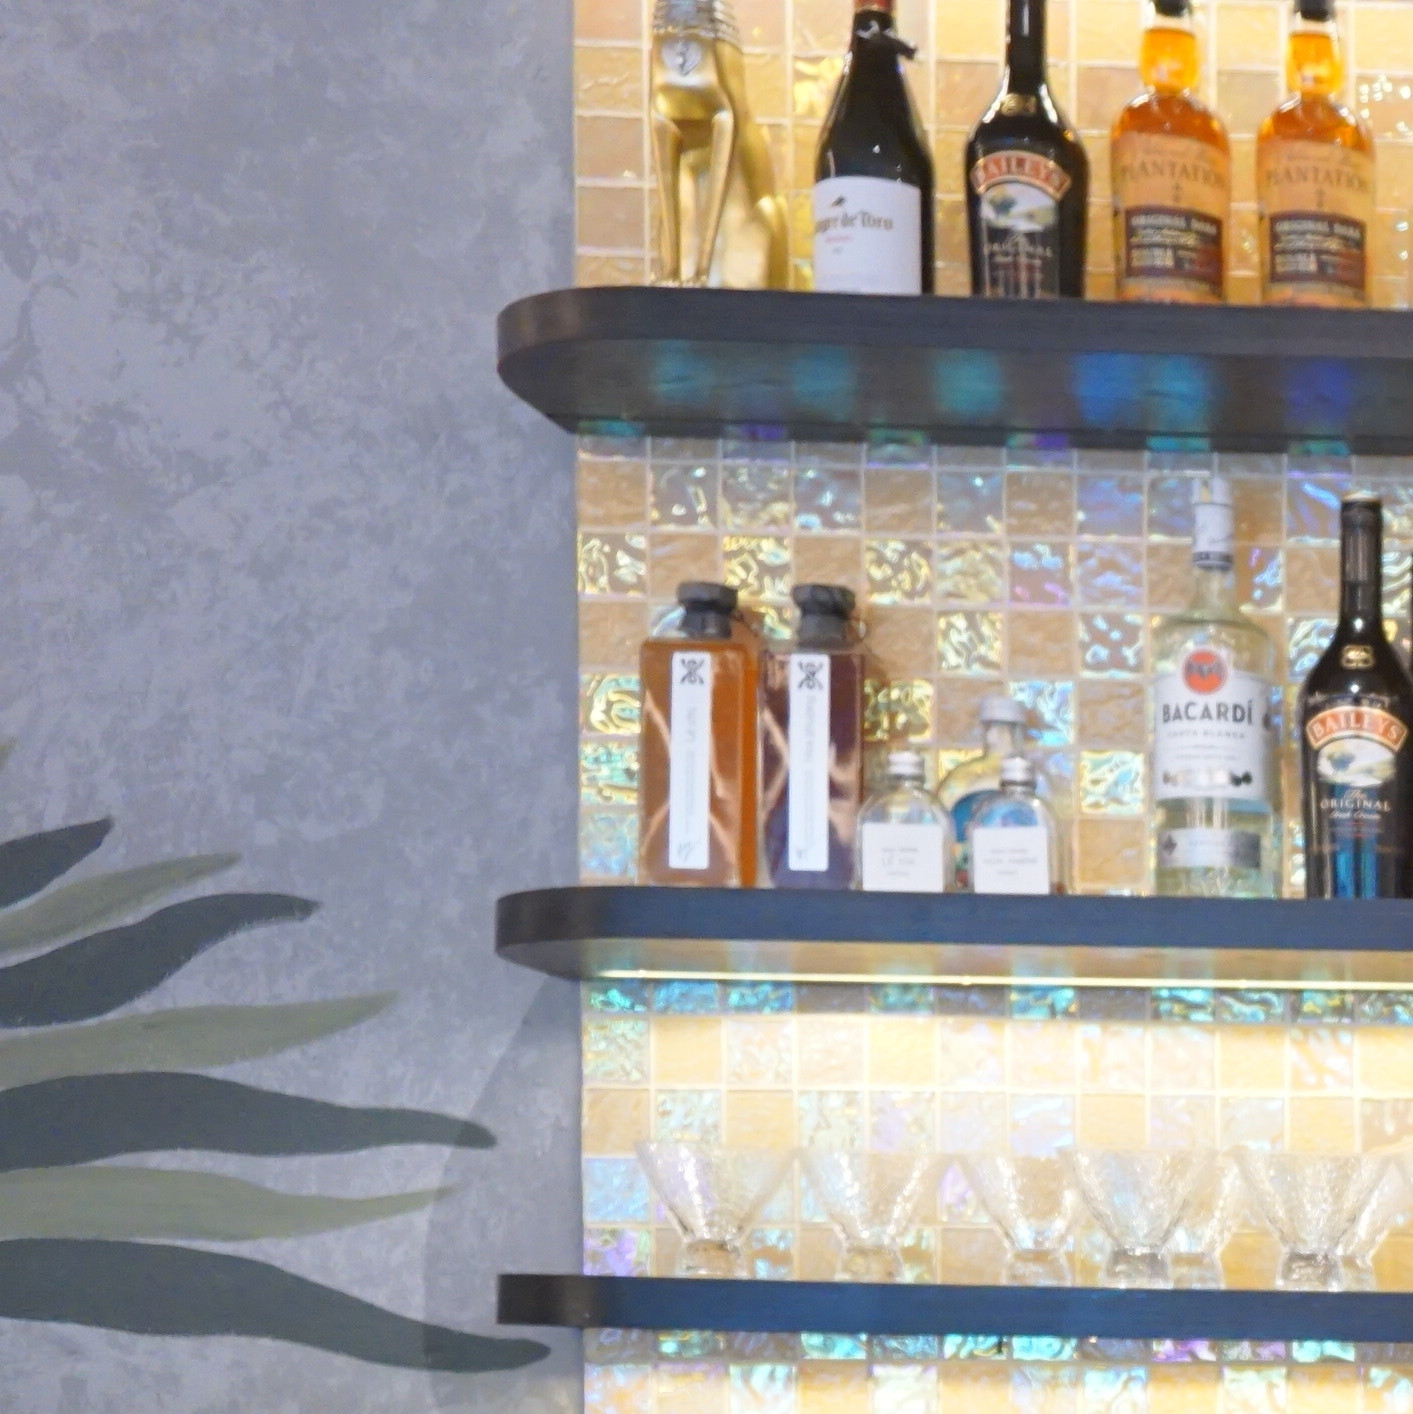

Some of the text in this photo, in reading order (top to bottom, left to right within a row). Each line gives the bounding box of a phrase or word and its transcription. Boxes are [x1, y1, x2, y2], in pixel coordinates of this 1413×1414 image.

[973, 155, 1066, 191] BAILEYS
[1313, 711, 1400, 740] BAILEYS
[1320, 798, 1391, 812] ORIGINAL
